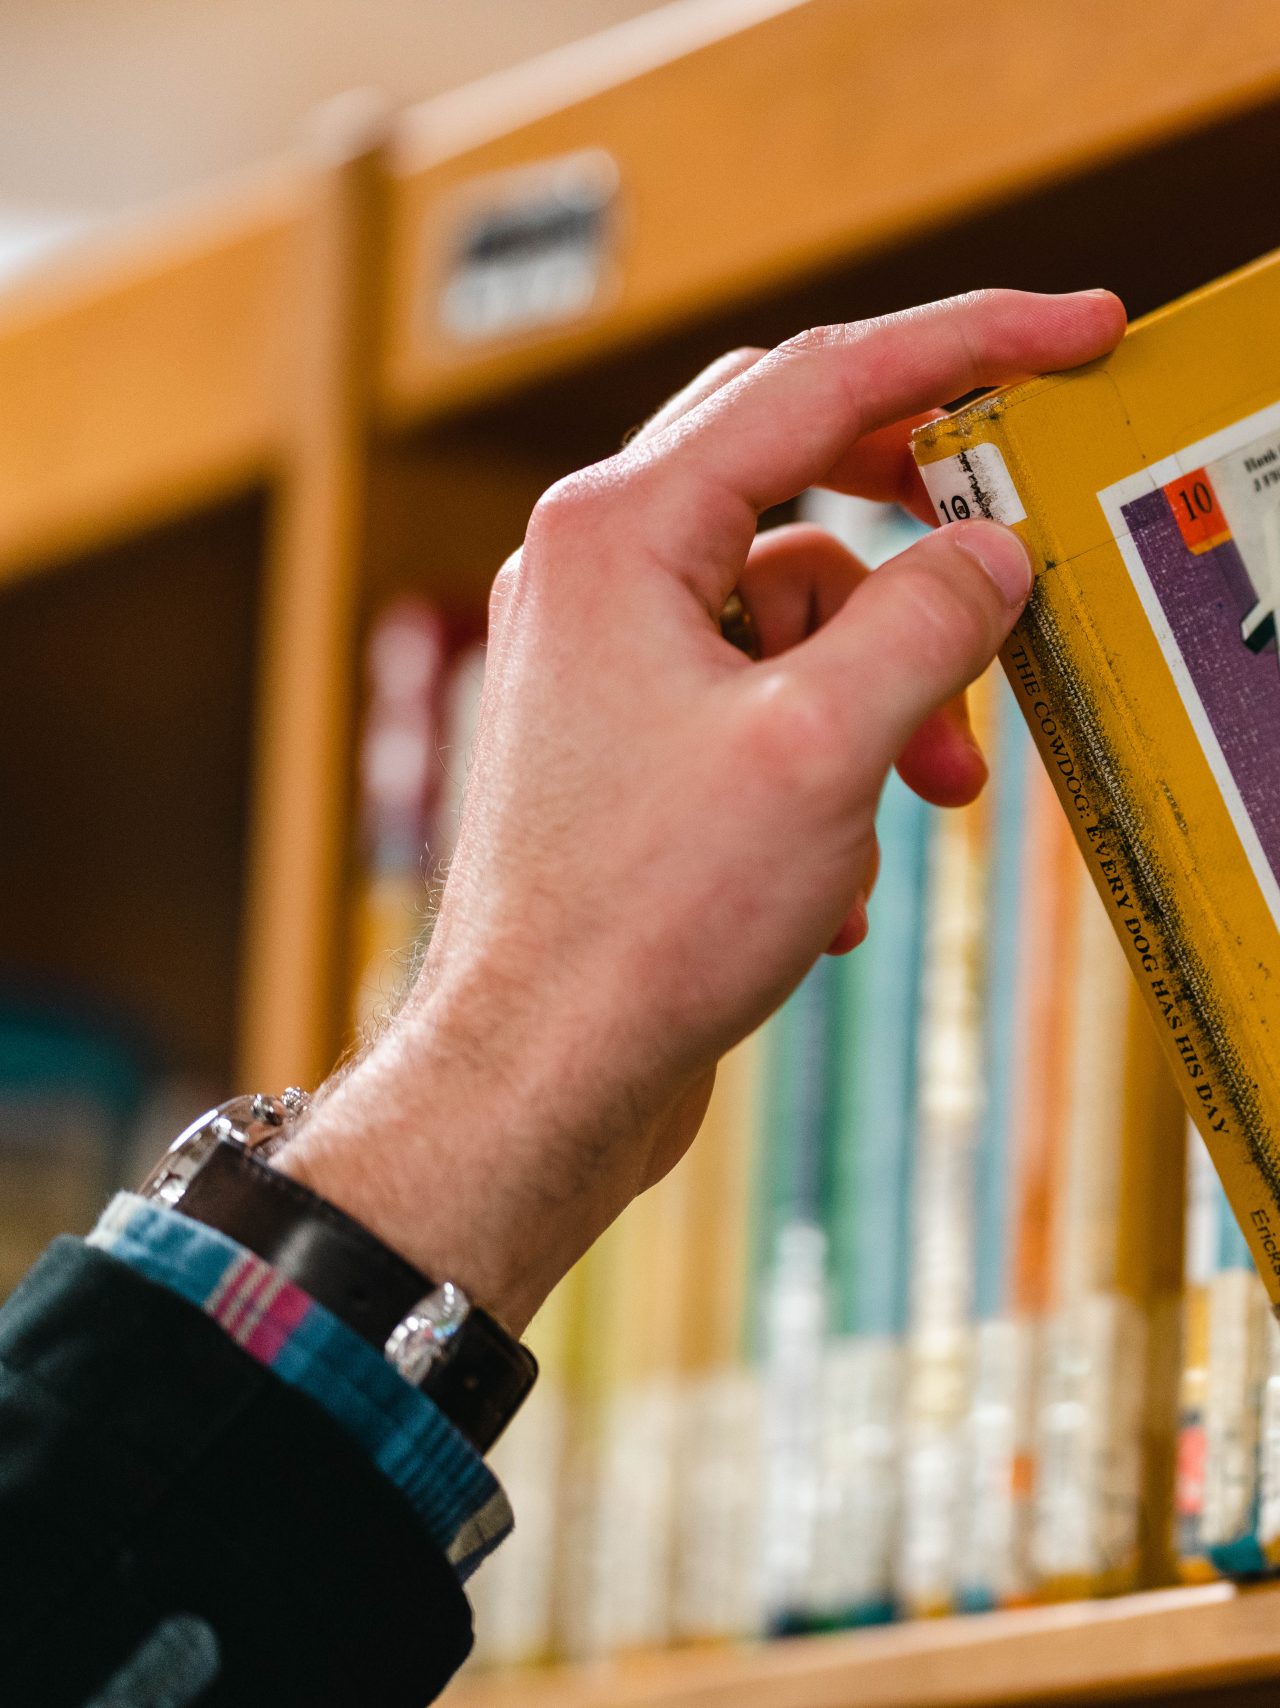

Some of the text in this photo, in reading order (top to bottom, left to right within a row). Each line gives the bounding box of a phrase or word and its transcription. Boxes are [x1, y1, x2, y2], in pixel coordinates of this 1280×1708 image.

[939, 495, 970, 523] 10
[1178, 481, 1214, 522] 10
[1011, 645, 1230, 1136] THE COWDOG: EVERY DOG HAS HIS DAY
